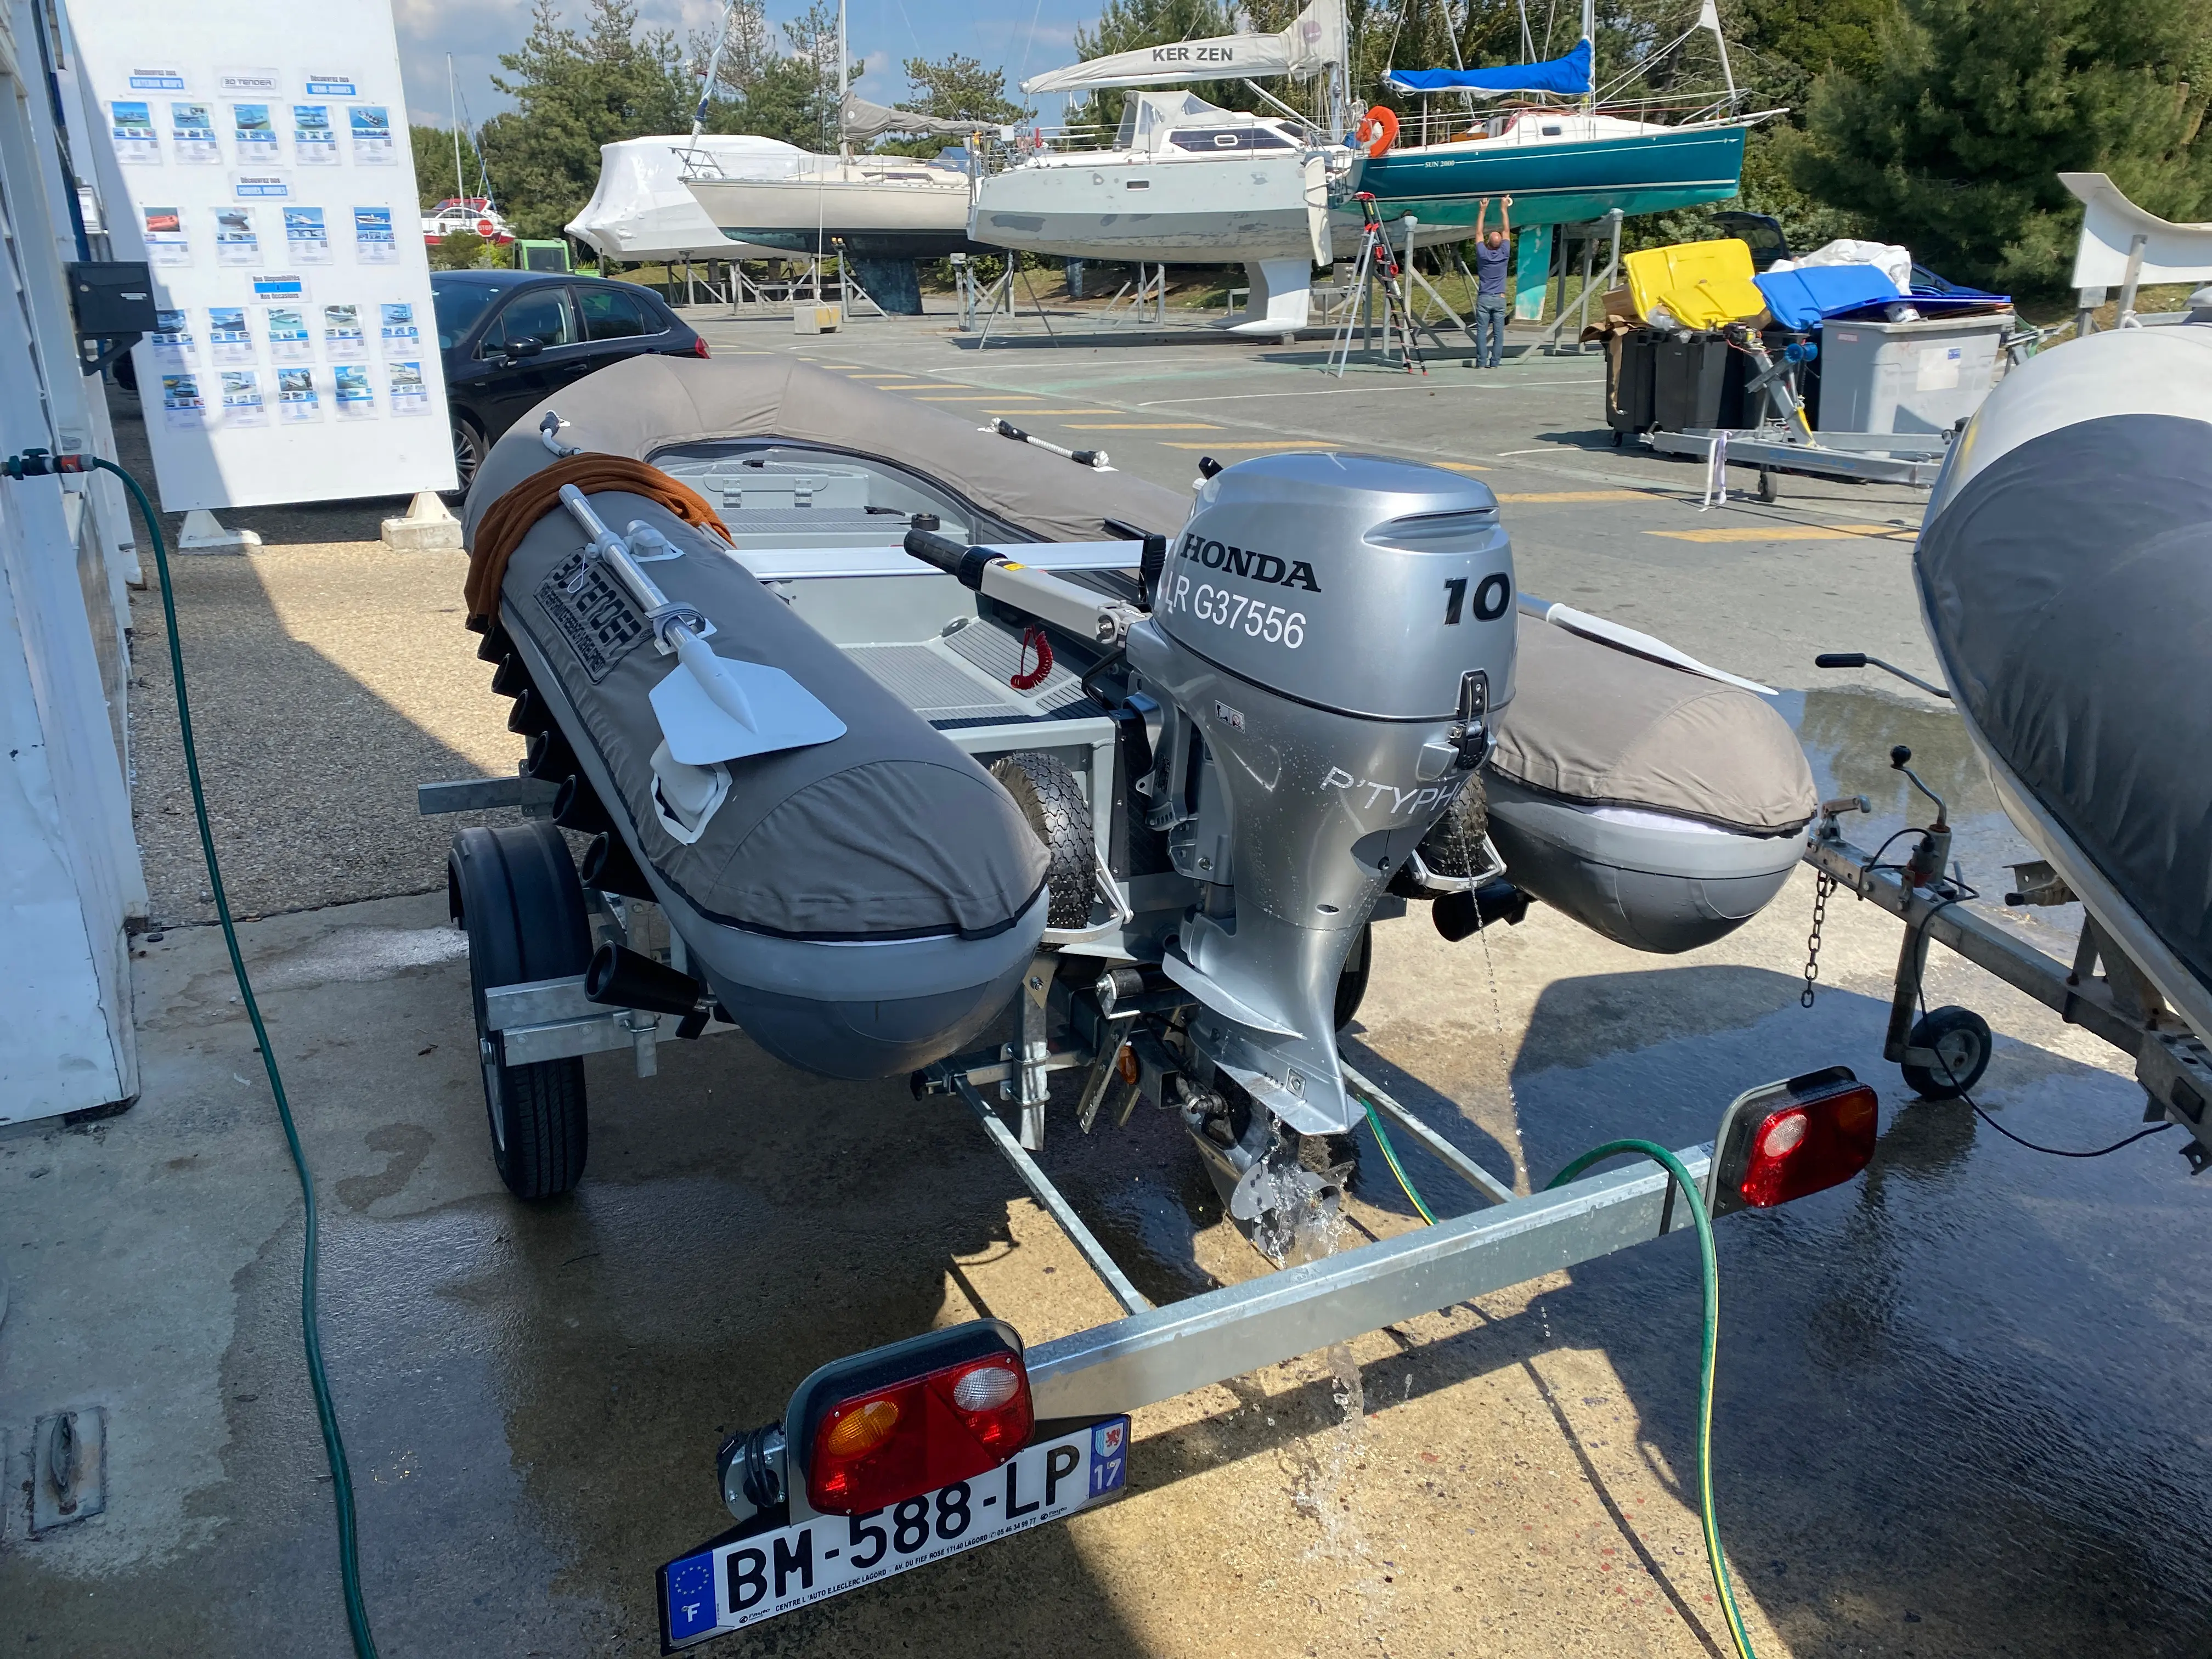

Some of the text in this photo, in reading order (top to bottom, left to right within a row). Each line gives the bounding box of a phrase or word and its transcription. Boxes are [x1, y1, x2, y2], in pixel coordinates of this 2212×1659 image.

[1153, 47, 1233, 61] KER ZEN
[1180, 533, 1322, 592] HONDA
[1194, 584, 1306, 649] G37556
[1443, 572, 1510, 625] 10
[1094, 1458, 1121, 1490] 17
[726, 1444, 1080, 1614] BM-588-LP
[776, 1598, 800, 1612] CENTRE
[827, 1578, 861, 1594] E.LECLERC
[862, 1568, 887, 1583] LAGORD
[894, 1564, 904, 1572] AV.
[915, 1555, 928, 1565] FIEF
[929, 1549, 944, 1560] ROSE
[946, 1543, 963, 1554] 17140
[964, 1534, 988, 1547] LAGORD
[1030, 1517, 1036, 1525] 77
[686, 1602, 701, 1622] F
